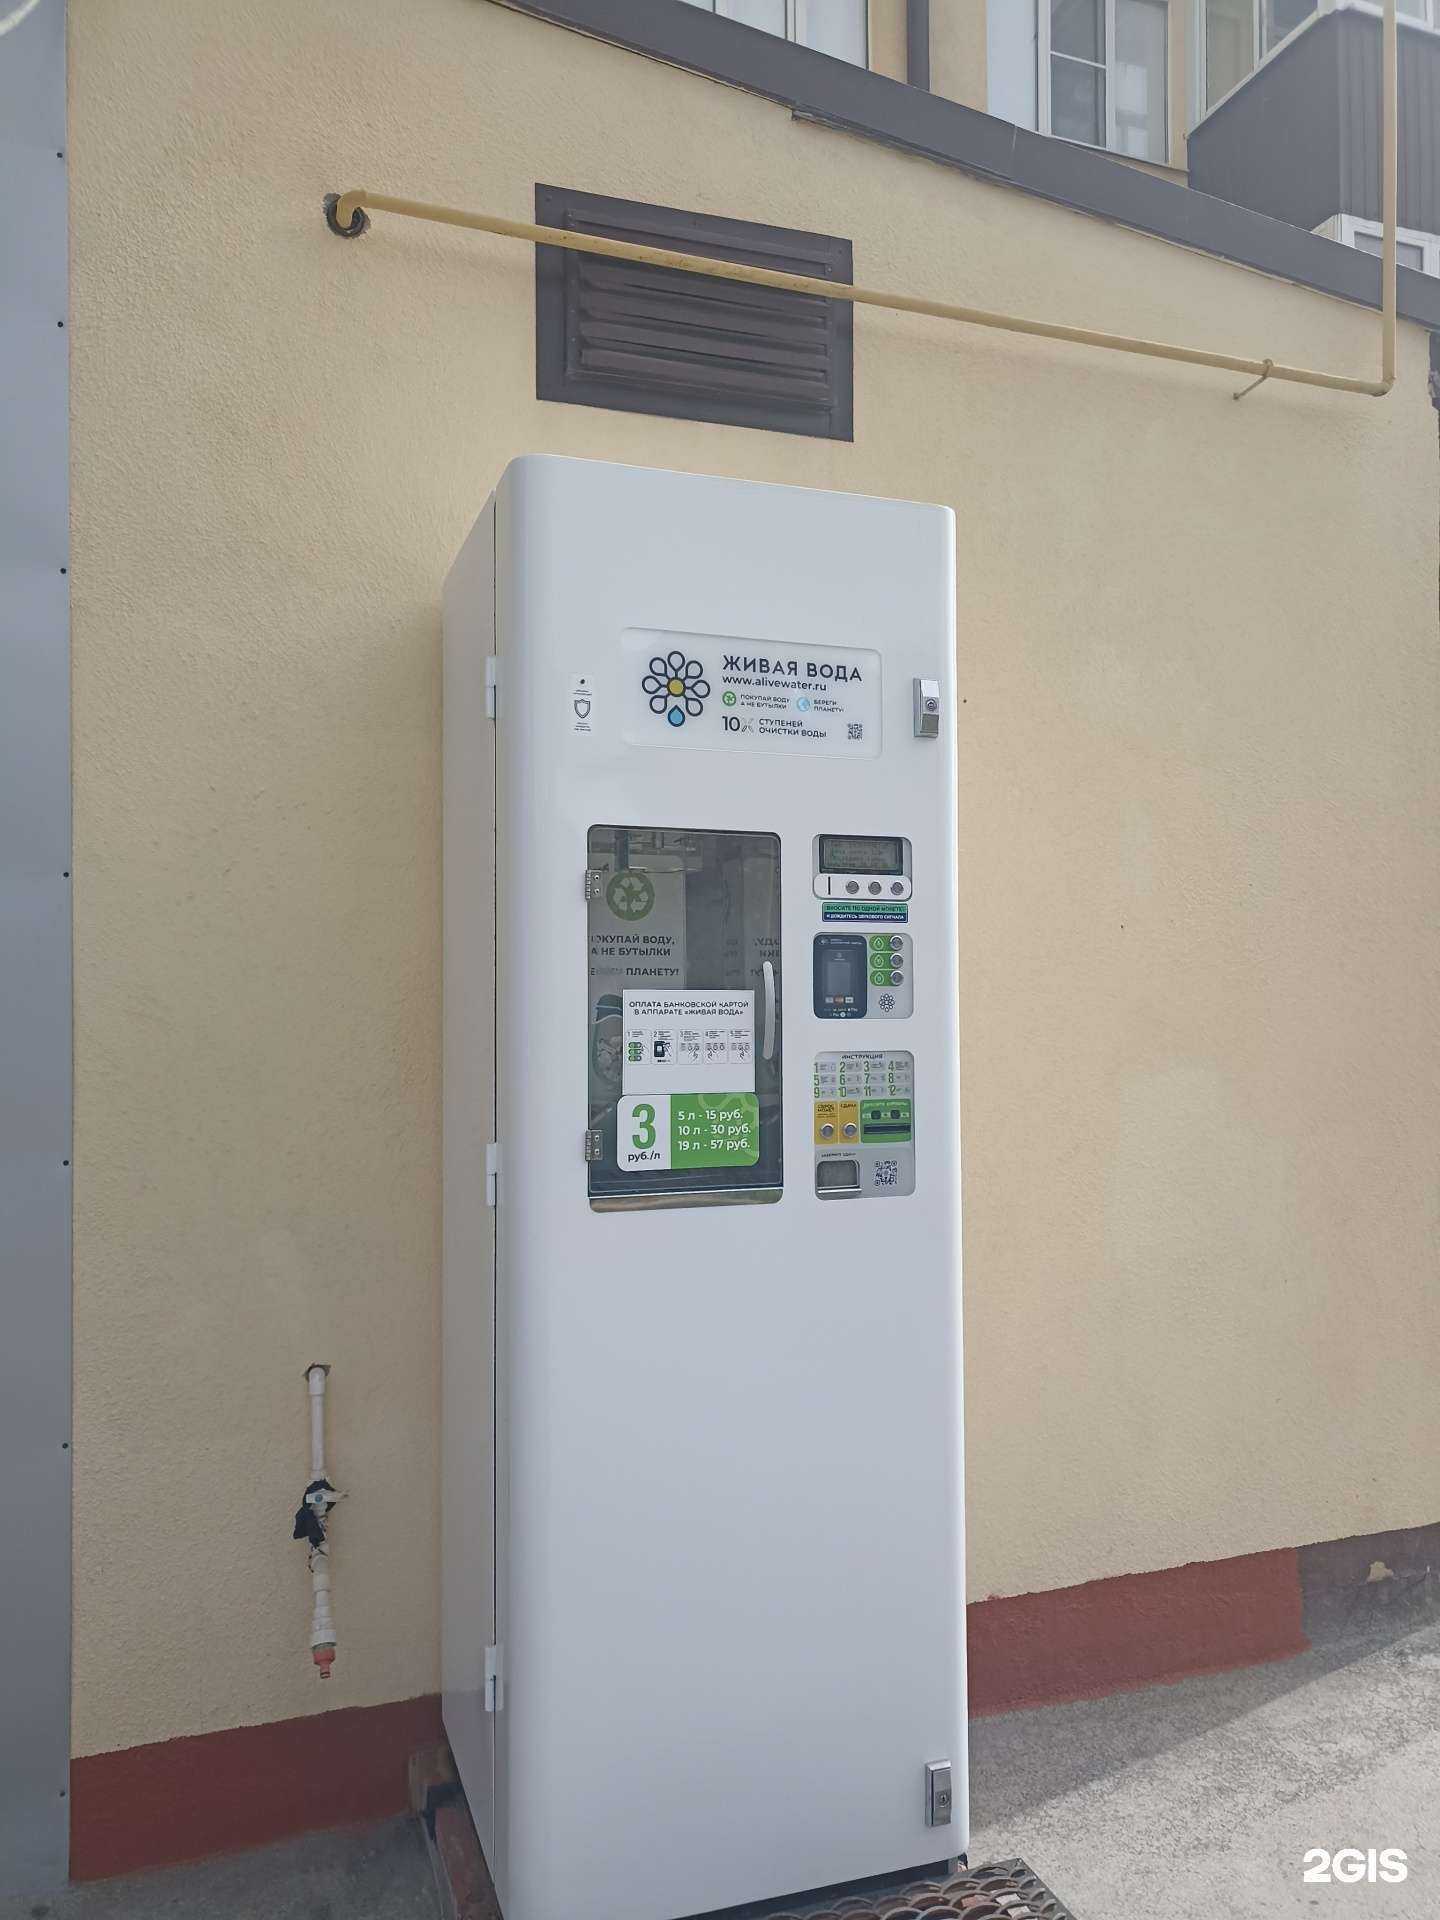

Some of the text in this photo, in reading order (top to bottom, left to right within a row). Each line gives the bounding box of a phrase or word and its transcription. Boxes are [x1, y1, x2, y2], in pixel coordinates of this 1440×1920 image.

[723, 655, 862, 682] ЖИВАЯ ВОДА
[722, 676, 826, 691] www.alivewater.ru
[722, 716, 740, 732] 10
[758, 718, 803, 728] СТУПЕНЕЙ
[758, 727, 827, 738] ОЧИСТКИ ВОДЫ
[643, 935, 675, 945] ВОДУ,
[601, 948, 615, 956] НЕ
[618, 948, 671, 956] БУТЫЛКИ
[626, 967, 679, 976] ПЛАНЕТУ!
[663, 1000, 718, 1008] БАНКОВСКОЙ
[719, 1000, 749, 1008] КАРТОЙ
[840, 1061, 845, 1073] 2
[864, 1061, 870, 1072] 3
[888, 1060, 895, 1072] 4
[814, 1075, 819, 1086] 5
[839, 1074, 845, 1085] 6
[864, 1073, 870, 1084] 7
[888, 1072, 894, 1083] 8
[814, 1087, 820, 1098] 9
[678, 1111, 685, 1120] 5
[687, 1112, 695, 1120] л
[706, 1110, 717, 1119] 15
[719, 1109, 743, 1121] руб.
[632, 1103, 656, 1149] 3
[678, 1126, 690, 1135] 10
[692, 1126, 701, 1135] л
[711, 1124, 725, 1134] 30
[728, 1123, 751, 1136] руб.
[678, 1141, 689, 1150] 19
[692, 1141, 700, 1150] л
[710, 1140, 723, 1149] 57
[726, 1138, 750, 1151] руб.
[628, 1150, 661, 1162] руб./л
